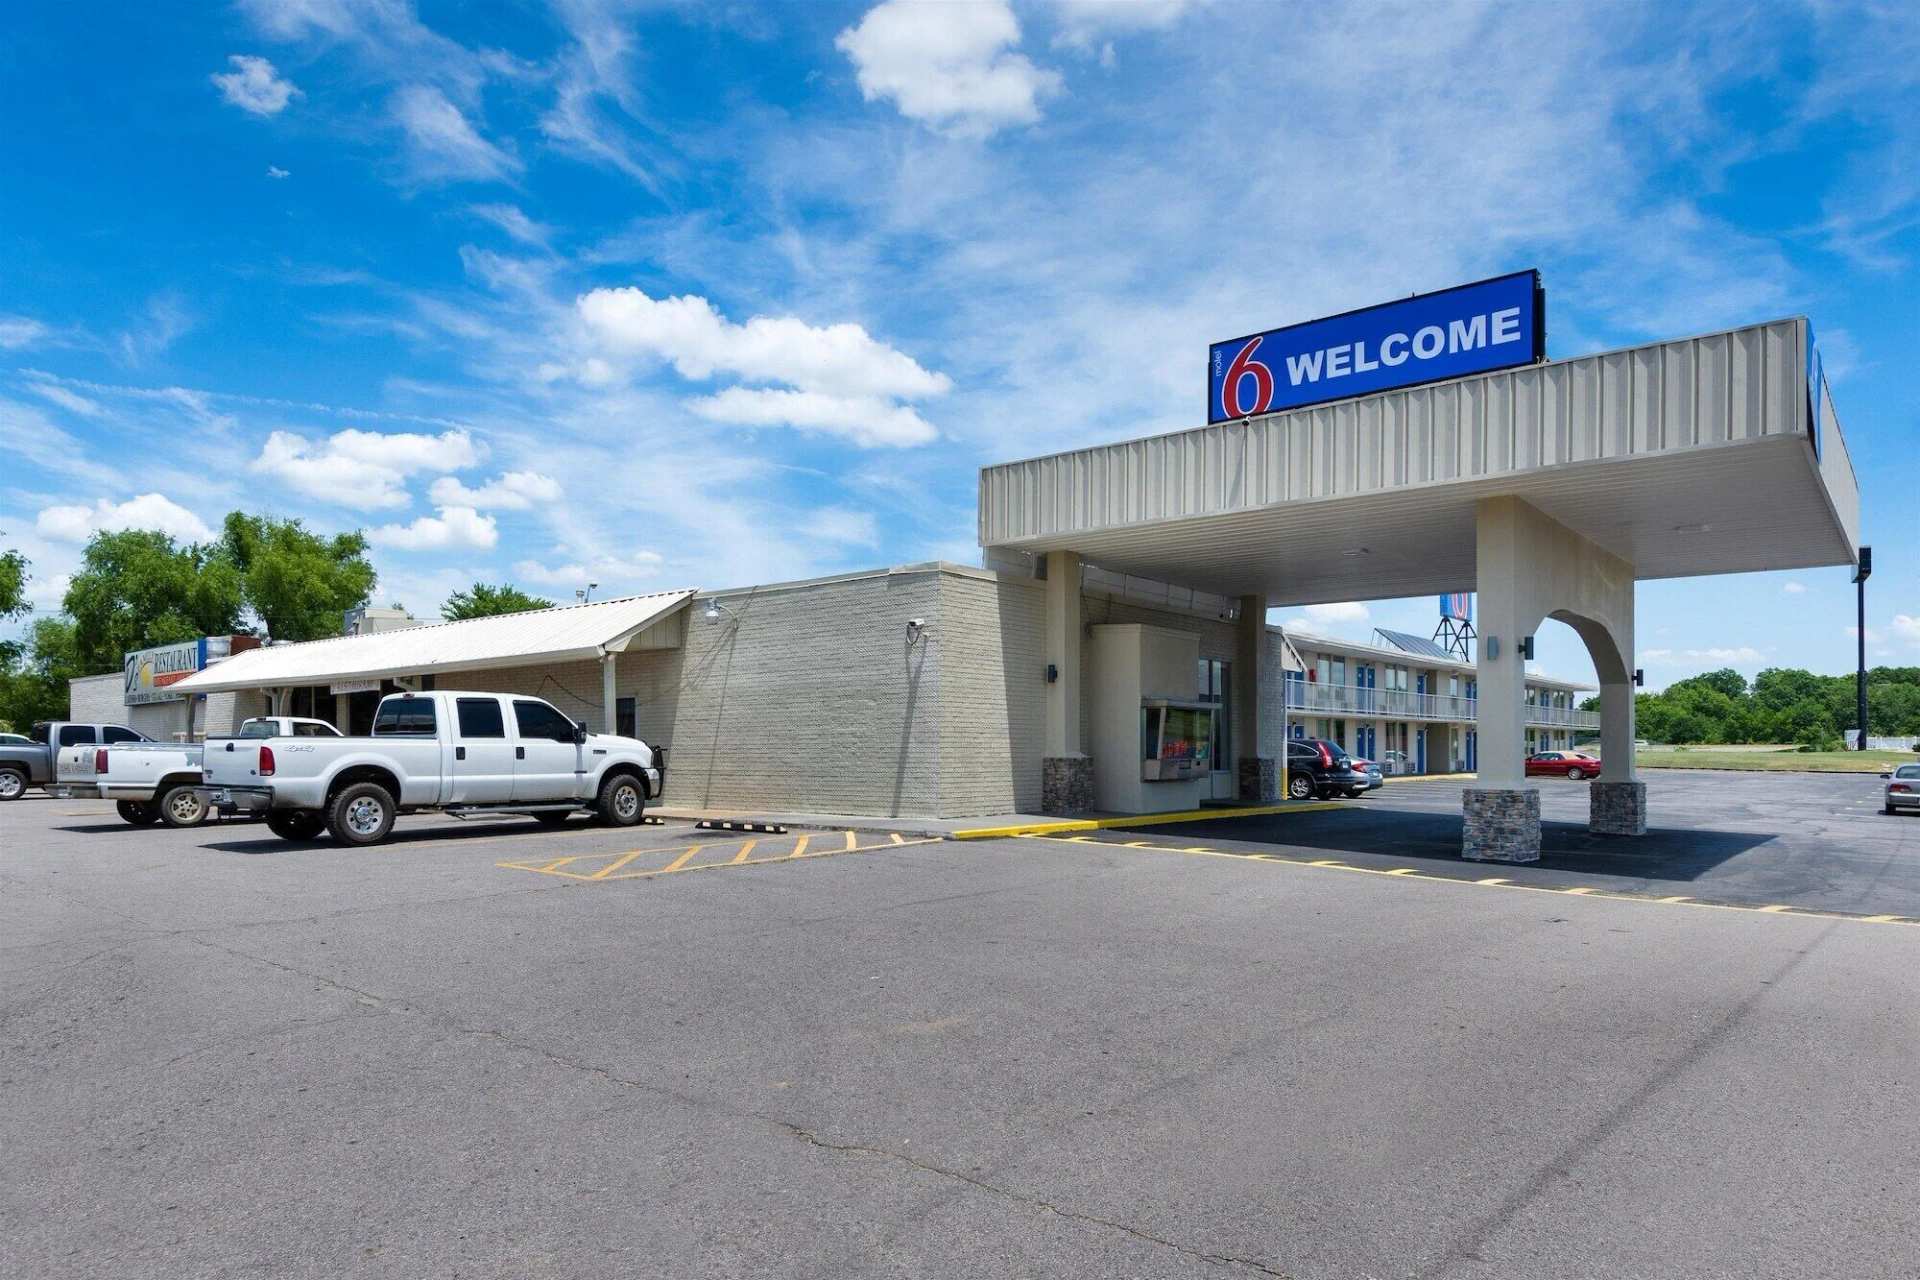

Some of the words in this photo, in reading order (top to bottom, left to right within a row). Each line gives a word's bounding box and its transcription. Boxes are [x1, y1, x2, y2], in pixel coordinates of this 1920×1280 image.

[1214, 350, 1222, 377] motel
[1221, 335, 1274, 418] 6
[1286, 307, 1521, 386] WELCOME
